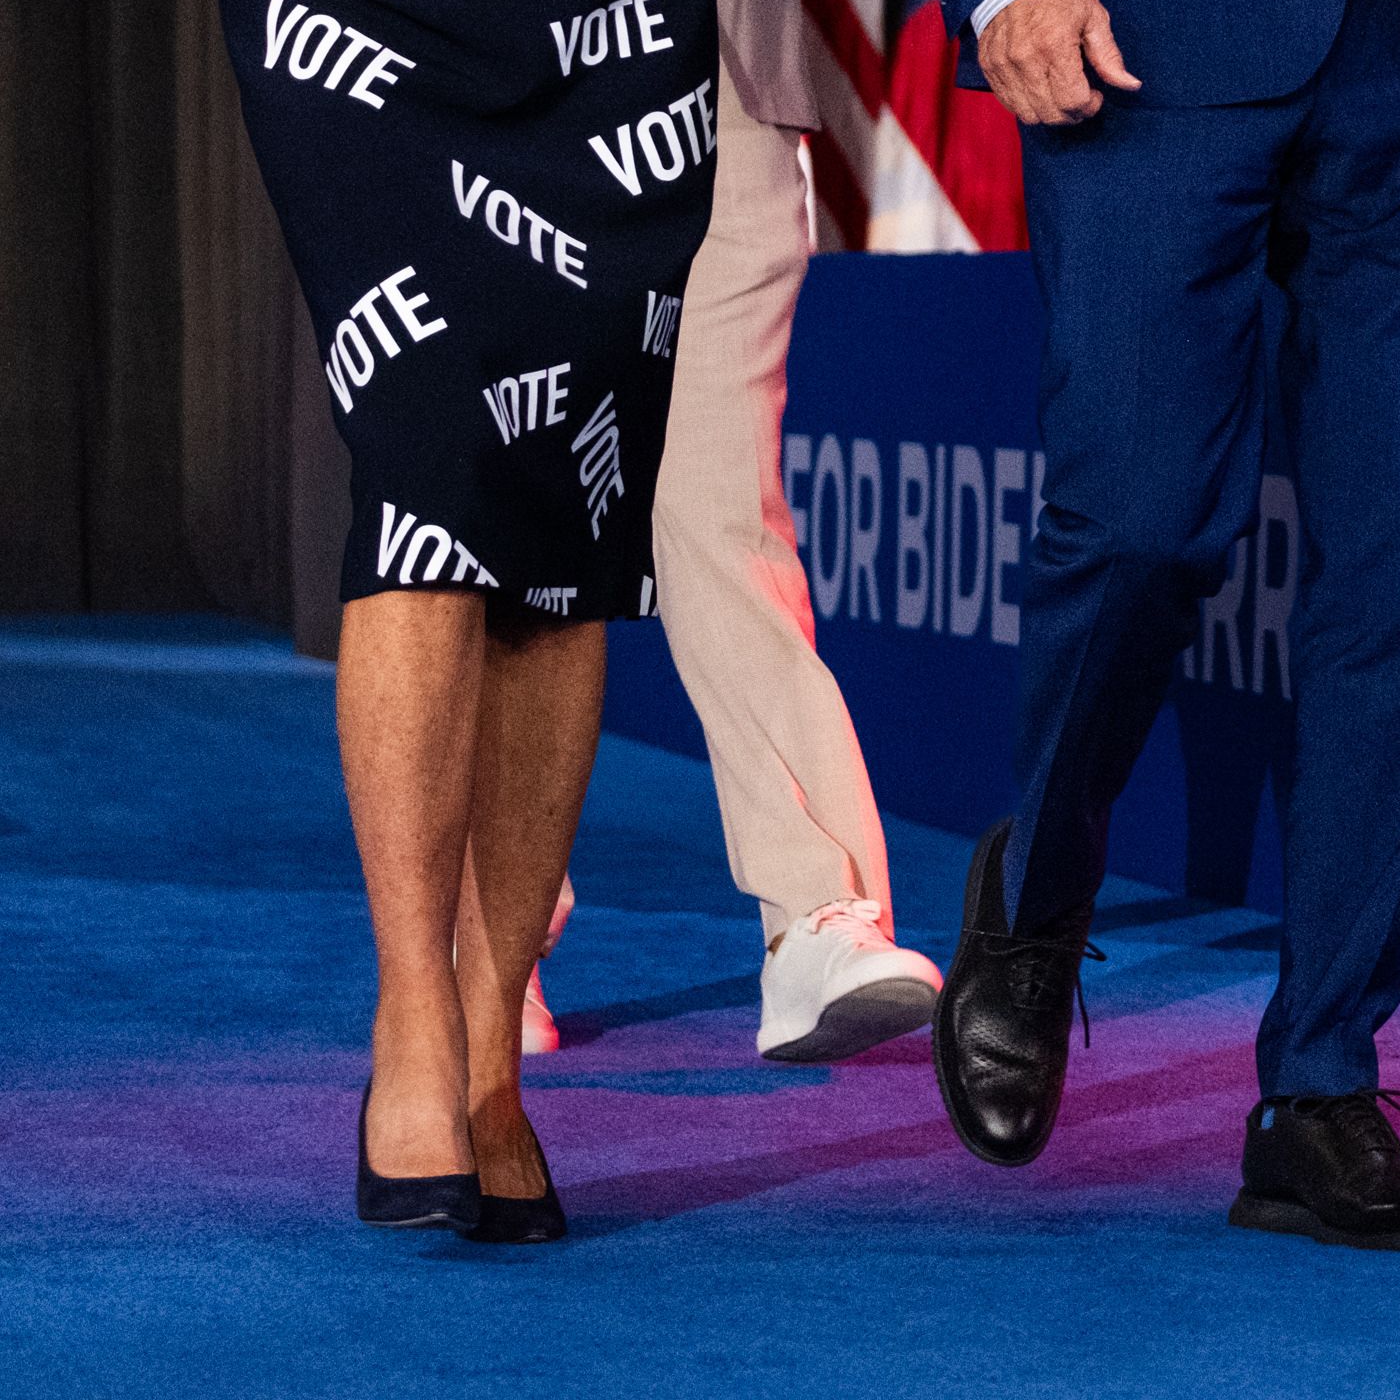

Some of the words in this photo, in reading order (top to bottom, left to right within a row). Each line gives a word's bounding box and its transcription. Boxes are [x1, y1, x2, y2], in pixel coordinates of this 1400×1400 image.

[588, 79, 718, 198] VOTE
[452, 160, 588, 290] VOTE
[325, 265, 448, 415] VOTE
[483, 362, 572, 446] VOTE
[783, 433, 881, 623] FOR
